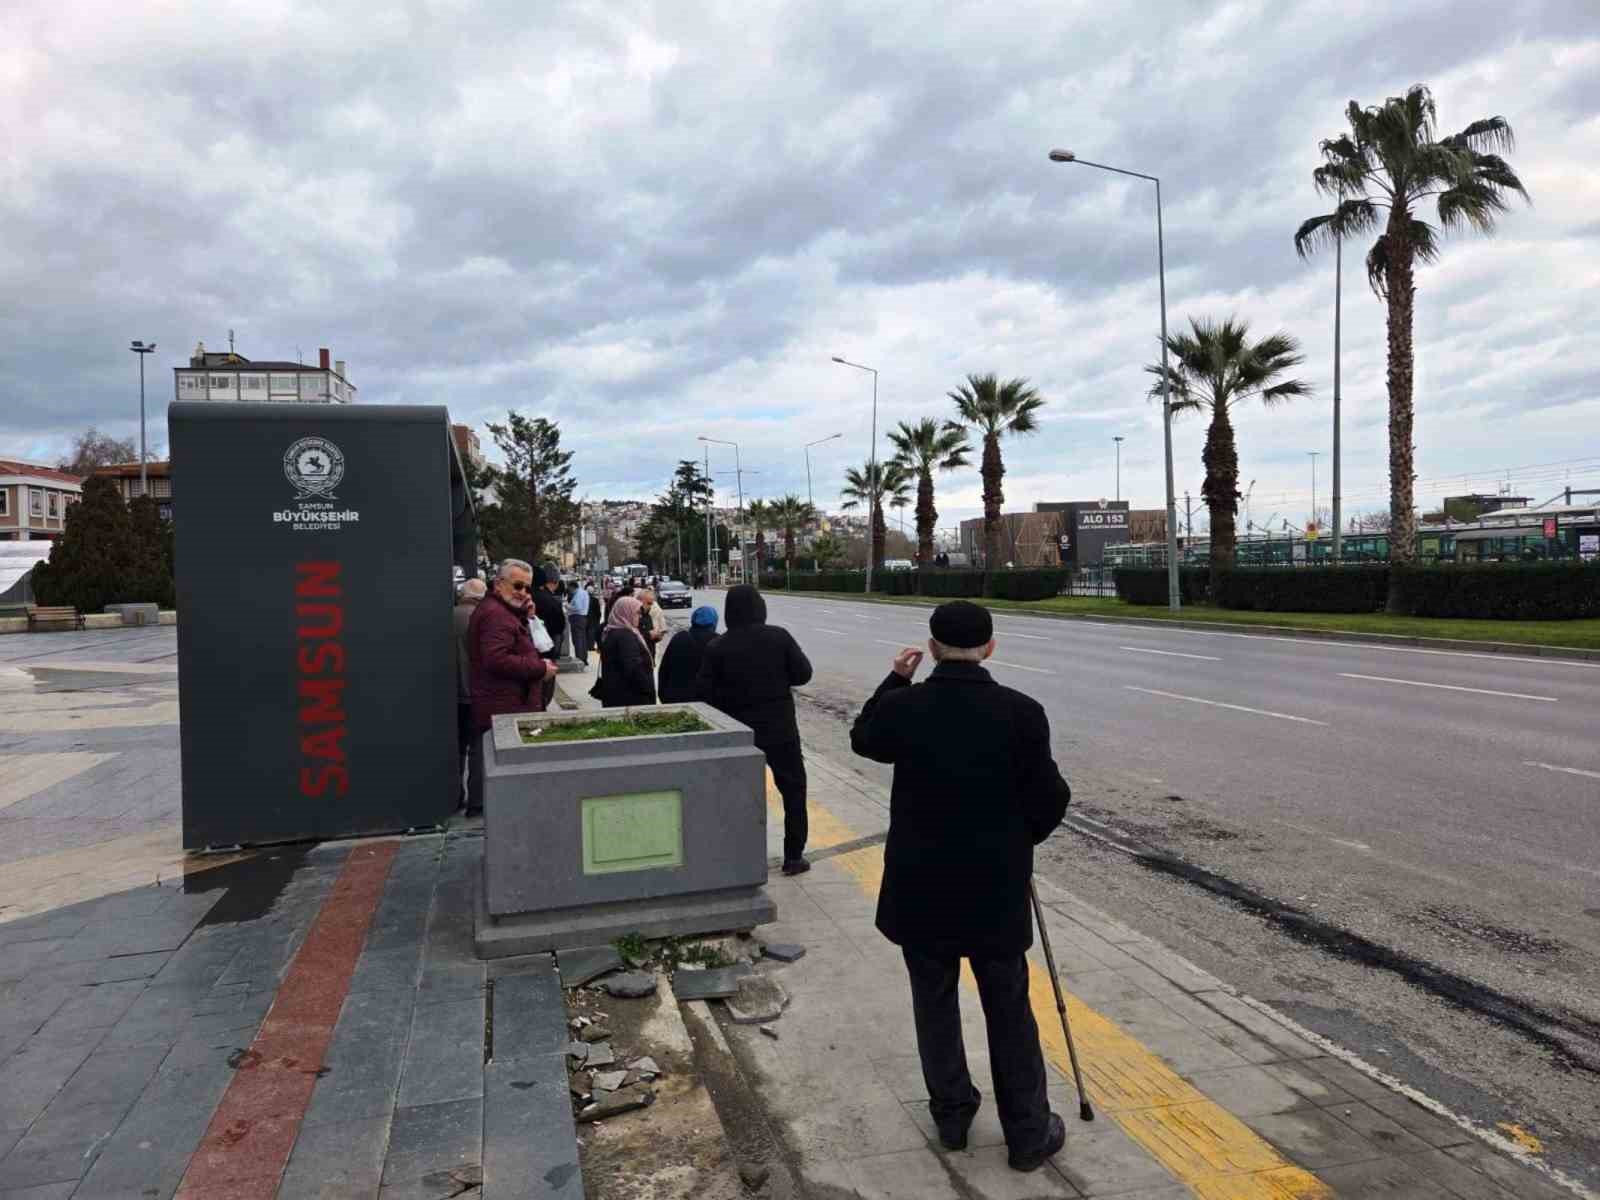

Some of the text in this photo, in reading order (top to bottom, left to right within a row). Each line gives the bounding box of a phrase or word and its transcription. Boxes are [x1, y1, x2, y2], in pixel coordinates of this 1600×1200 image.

[272, 509, 360, 522] BÜYÜKŞEHİR
[1083, 514, 1124, 524] ALO 153
[295, 560, 349, 797] SAMSUN
